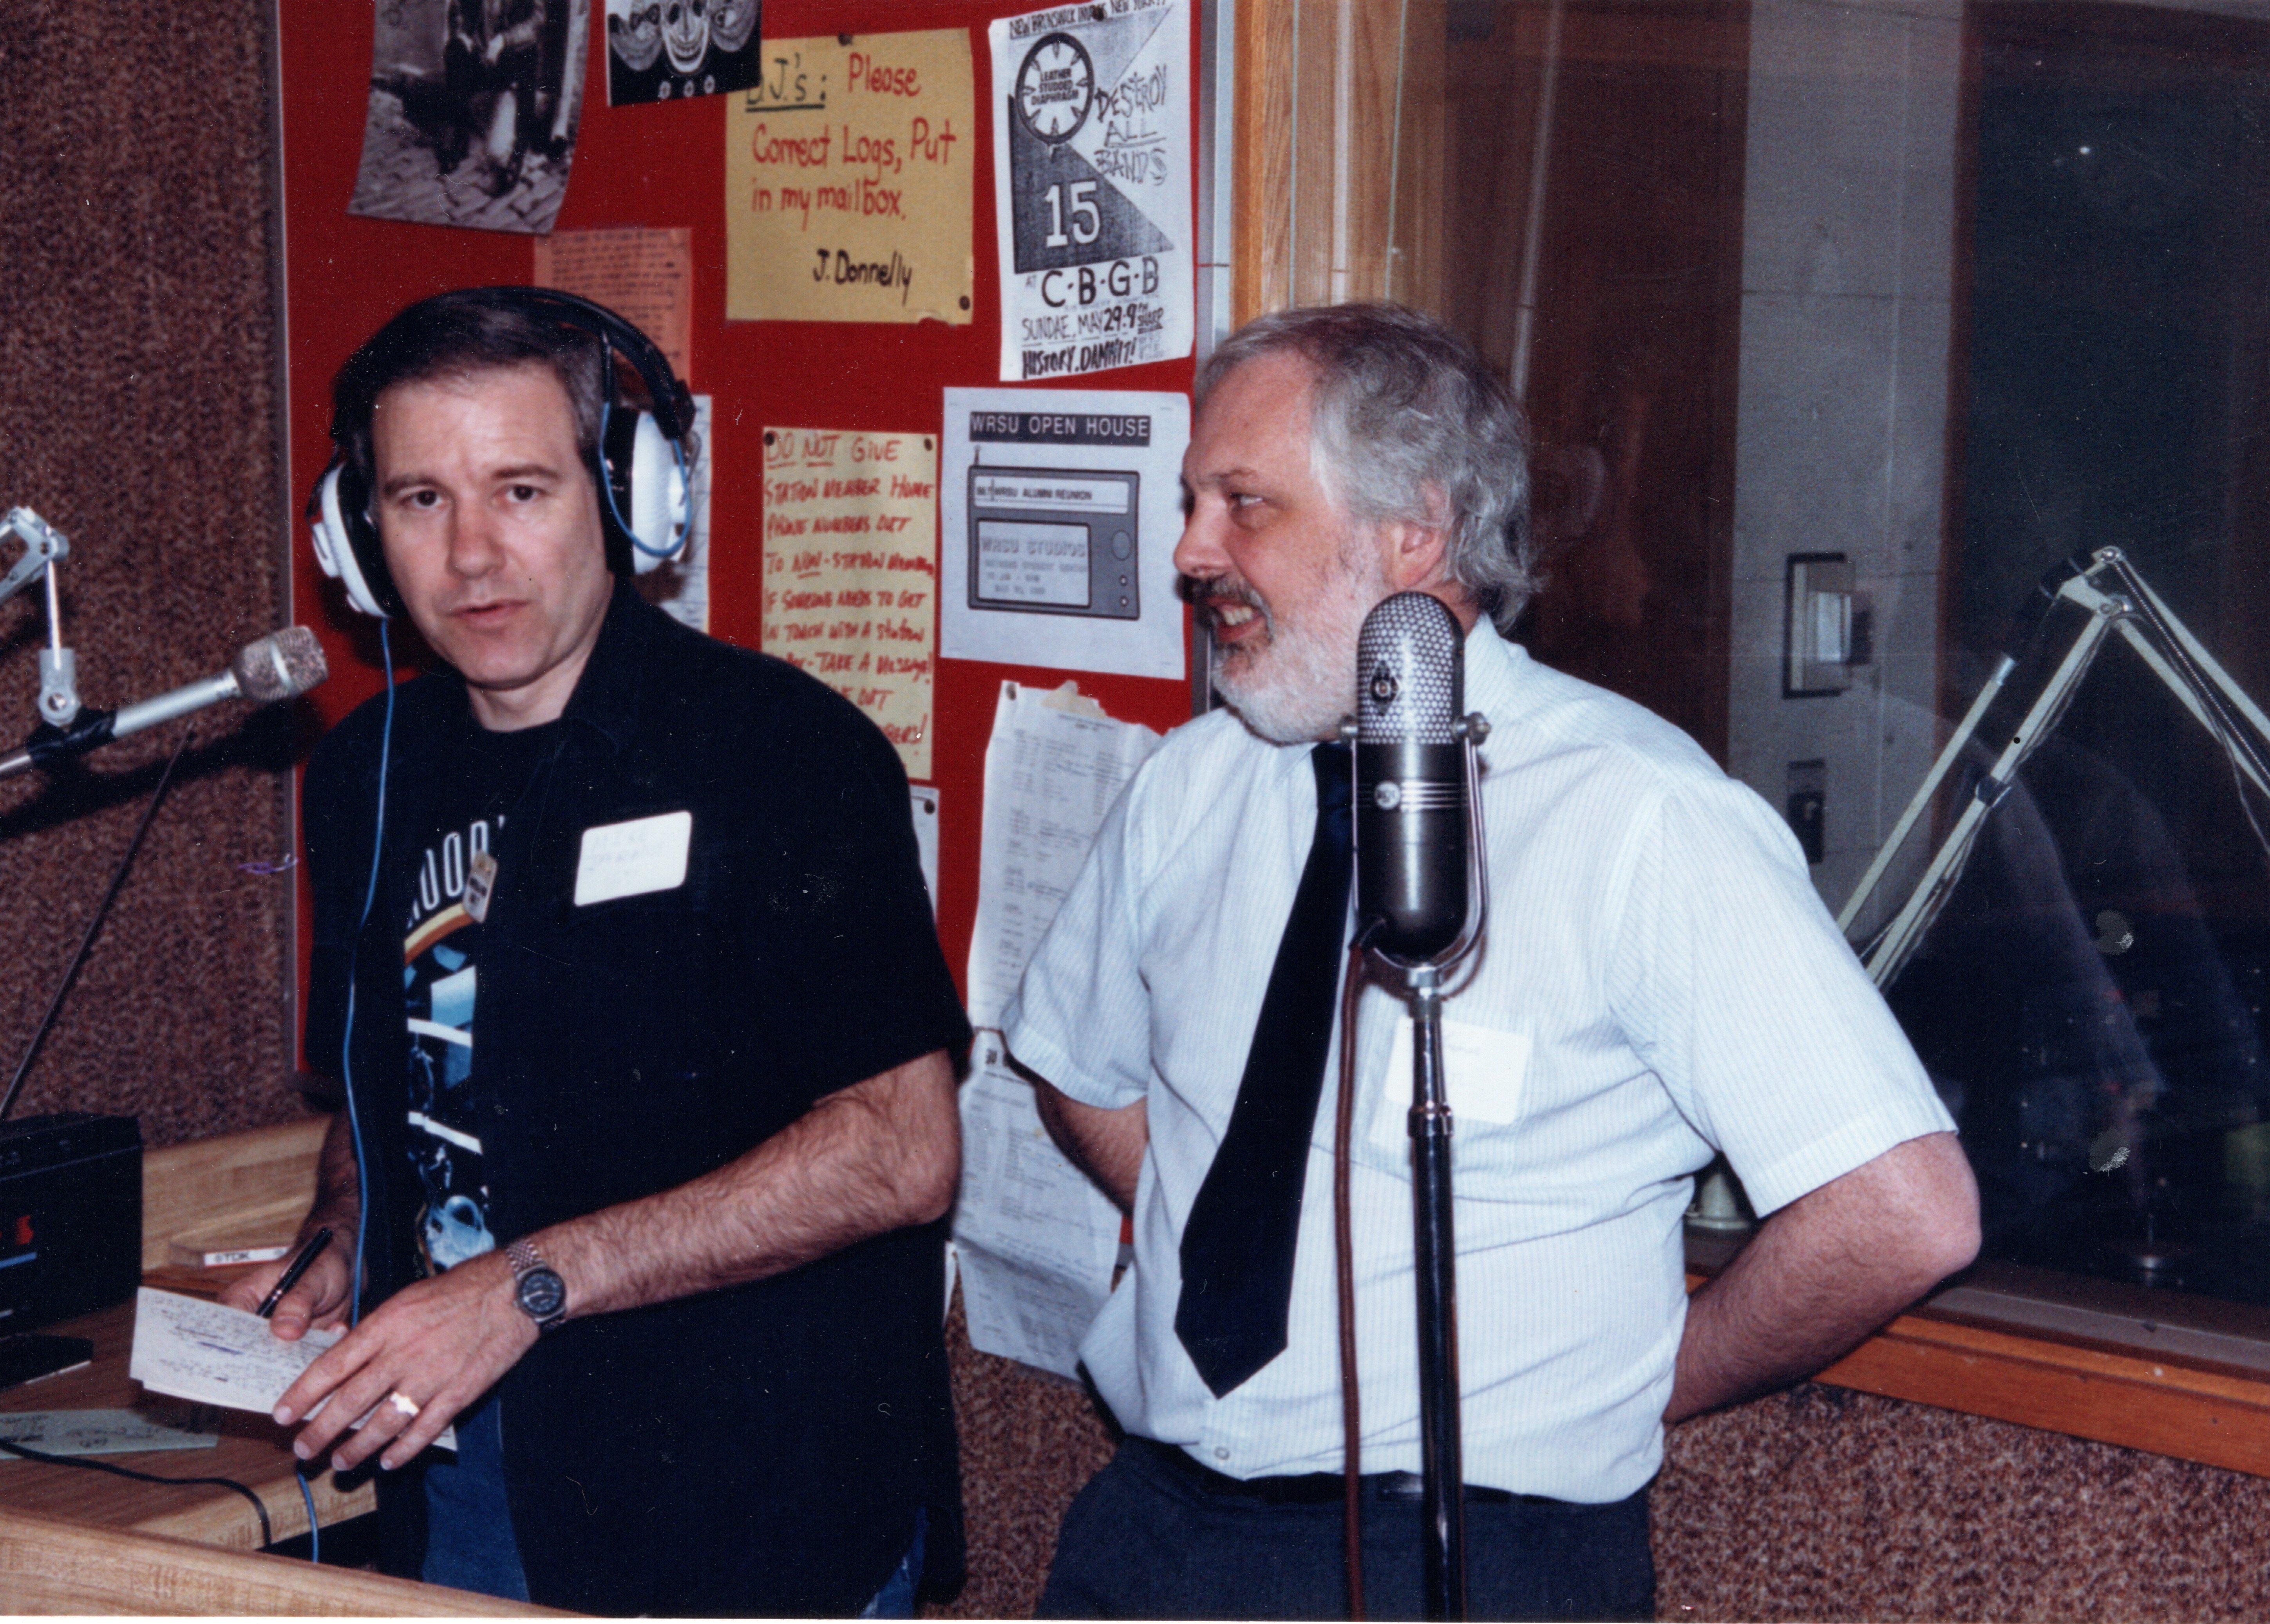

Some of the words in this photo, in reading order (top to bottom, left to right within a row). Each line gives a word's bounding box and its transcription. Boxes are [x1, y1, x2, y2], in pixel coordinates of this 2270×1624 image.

[848, 52, 921, 97] Please
[1094, 63, 1166, 123] DESTROY
[1103, 118, 1158, 147] ALL
[752, 123, 830, 167] Correct
[843, 124, 902, 186] Logs,
[910, 117, 957, 165] Put
[1094, 148, 1167, 186] BANDS
[751, 177, 772, 212] in
[780, 186, 810, 232] my
[1045, 180, 1101, 248] 15
[1078, 309, 1103, 334] MAY
[970, 415, 1019, 434] WRSU
[1029, 416, 1076, 435] OPEN
[1086, 417, 1149, 437] HOUSE
[802, 432, 841, 459] NOT
[1022, 488, 1053, 499] ALUMNI
[1055, 489, 1092, 500] REUNION
[857, 651, 870, 671] A
